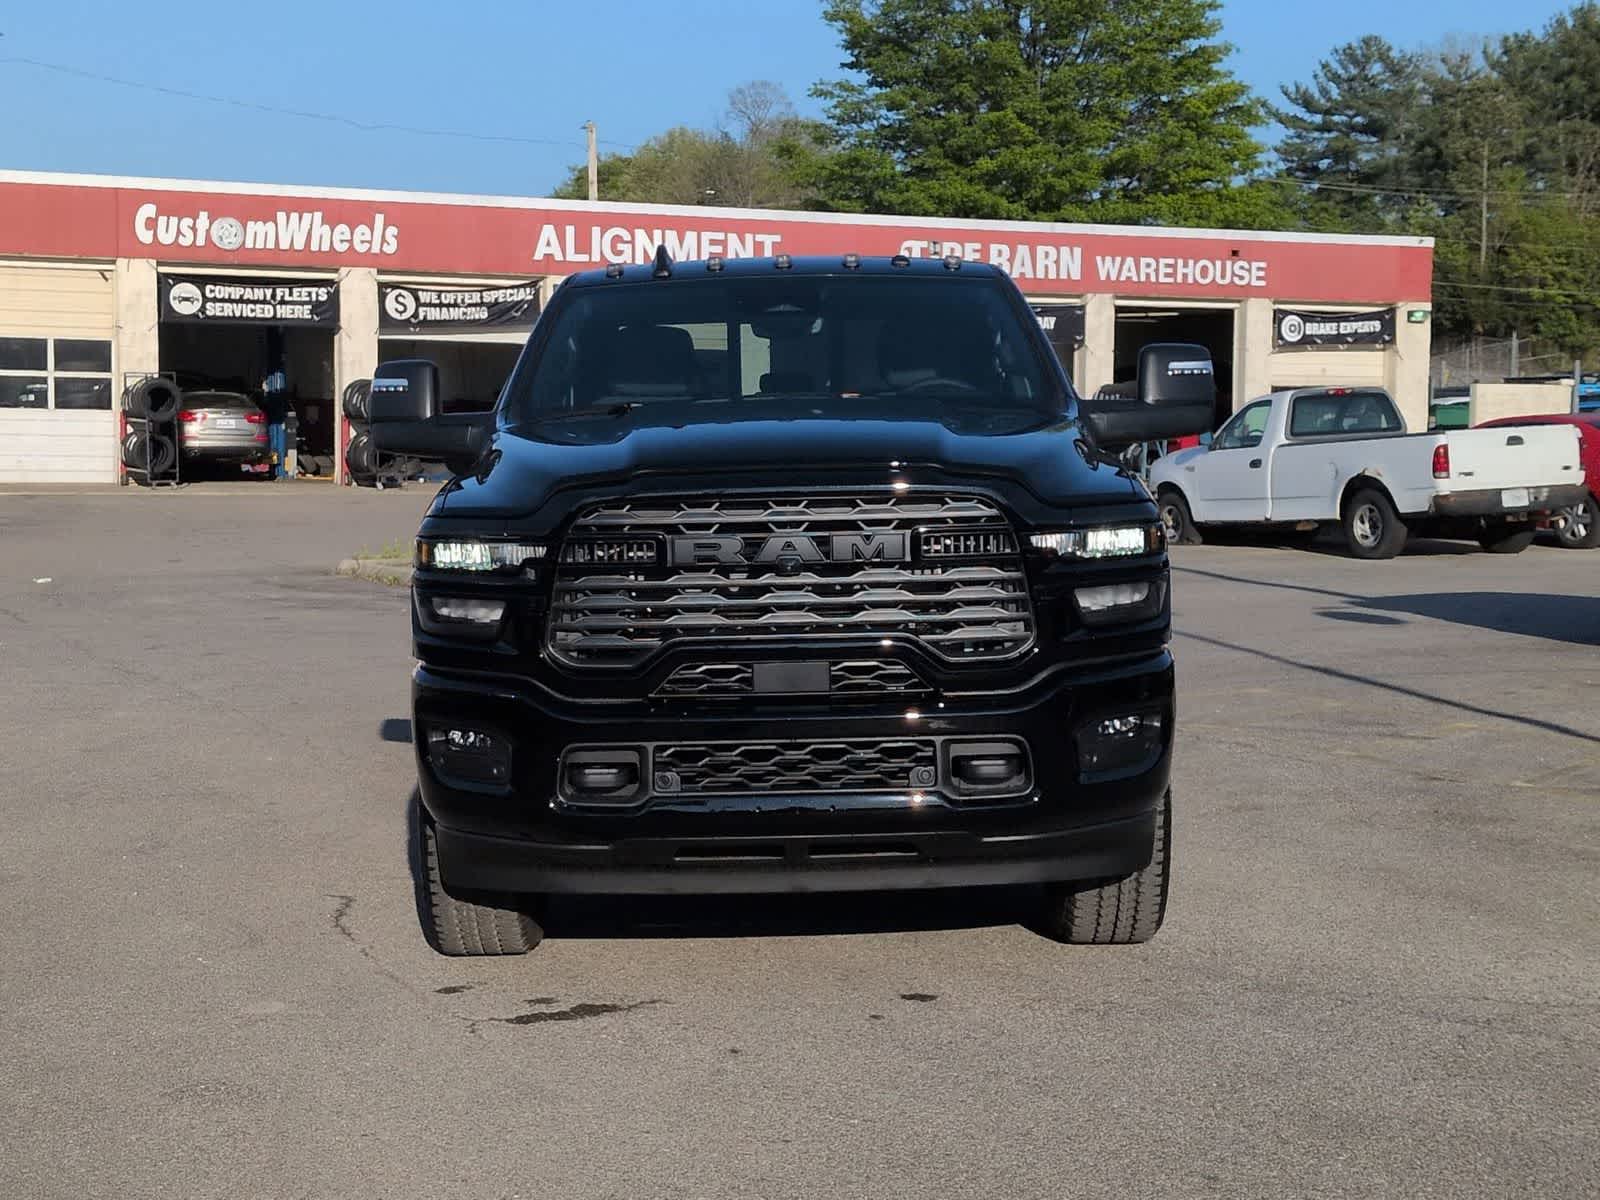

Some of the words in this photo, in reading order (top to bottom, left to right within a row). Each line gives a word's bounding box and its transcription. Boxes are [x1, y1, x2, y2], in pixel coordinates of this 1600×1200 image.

[533, 224, 782, 265] ALIGNMENT
[988, 243, 1083, 281] BARN
[1095, 255, 1267, 287] WAREHOUSE
[205, 284, 272, 301] COMPANY
[276, 287, 328, 302] FLEETS
[418, 290, 440, 304] WE
[443, 291, 481, 304] OFFER
[482, 287, 535, 303] SPECIAL
[205, 302, 274, 319] SERVICED
[276, 304, 312, 319] HERE
[418, 306, 488, 321] FINANCING
[1305, 322, 1338, 335] BRAKE
[673, 534, 904, 564] RAM
